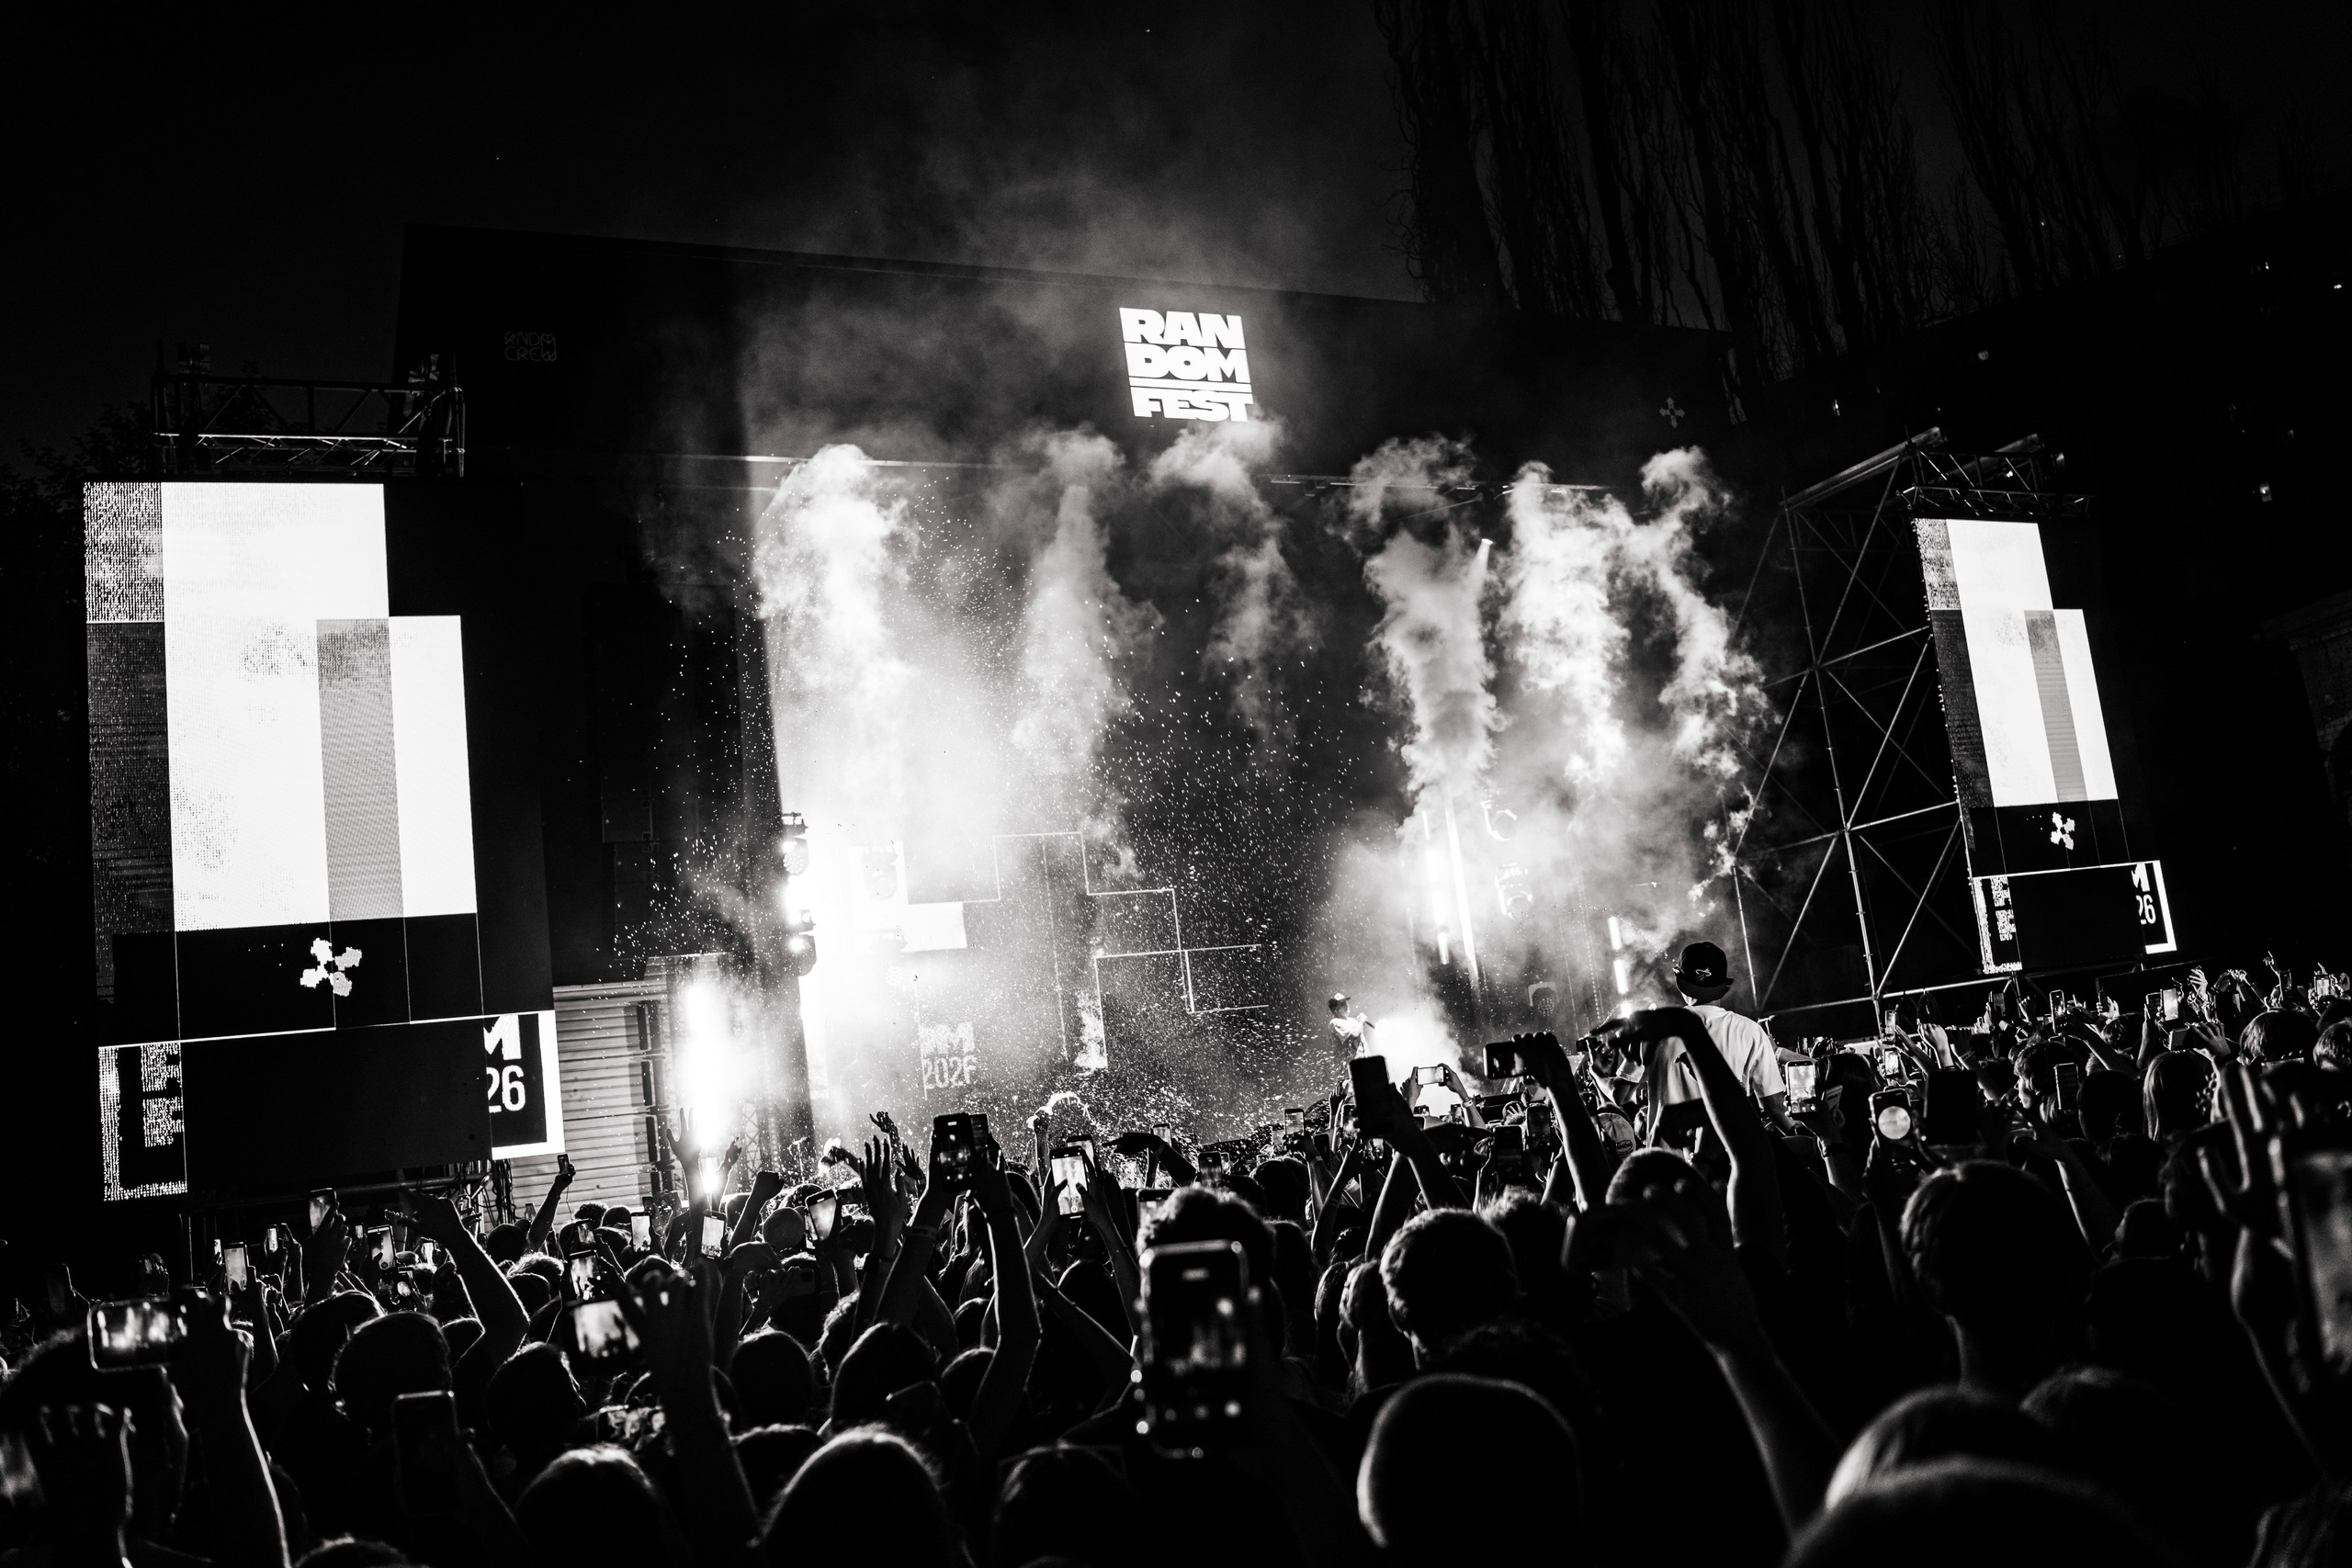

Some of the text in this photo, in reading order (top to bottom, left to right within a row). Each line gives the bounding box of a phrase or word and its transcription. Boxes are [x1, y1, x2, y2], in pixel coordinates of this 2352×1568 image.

[504, 331, 556, 346] RNDM
[1119, 307, 1246, 349] RAN
[504, 345, 558, 362] CREW
[1124, 342, 1251, 384] DOM
[1130, 386, 1254, 423] FEST
